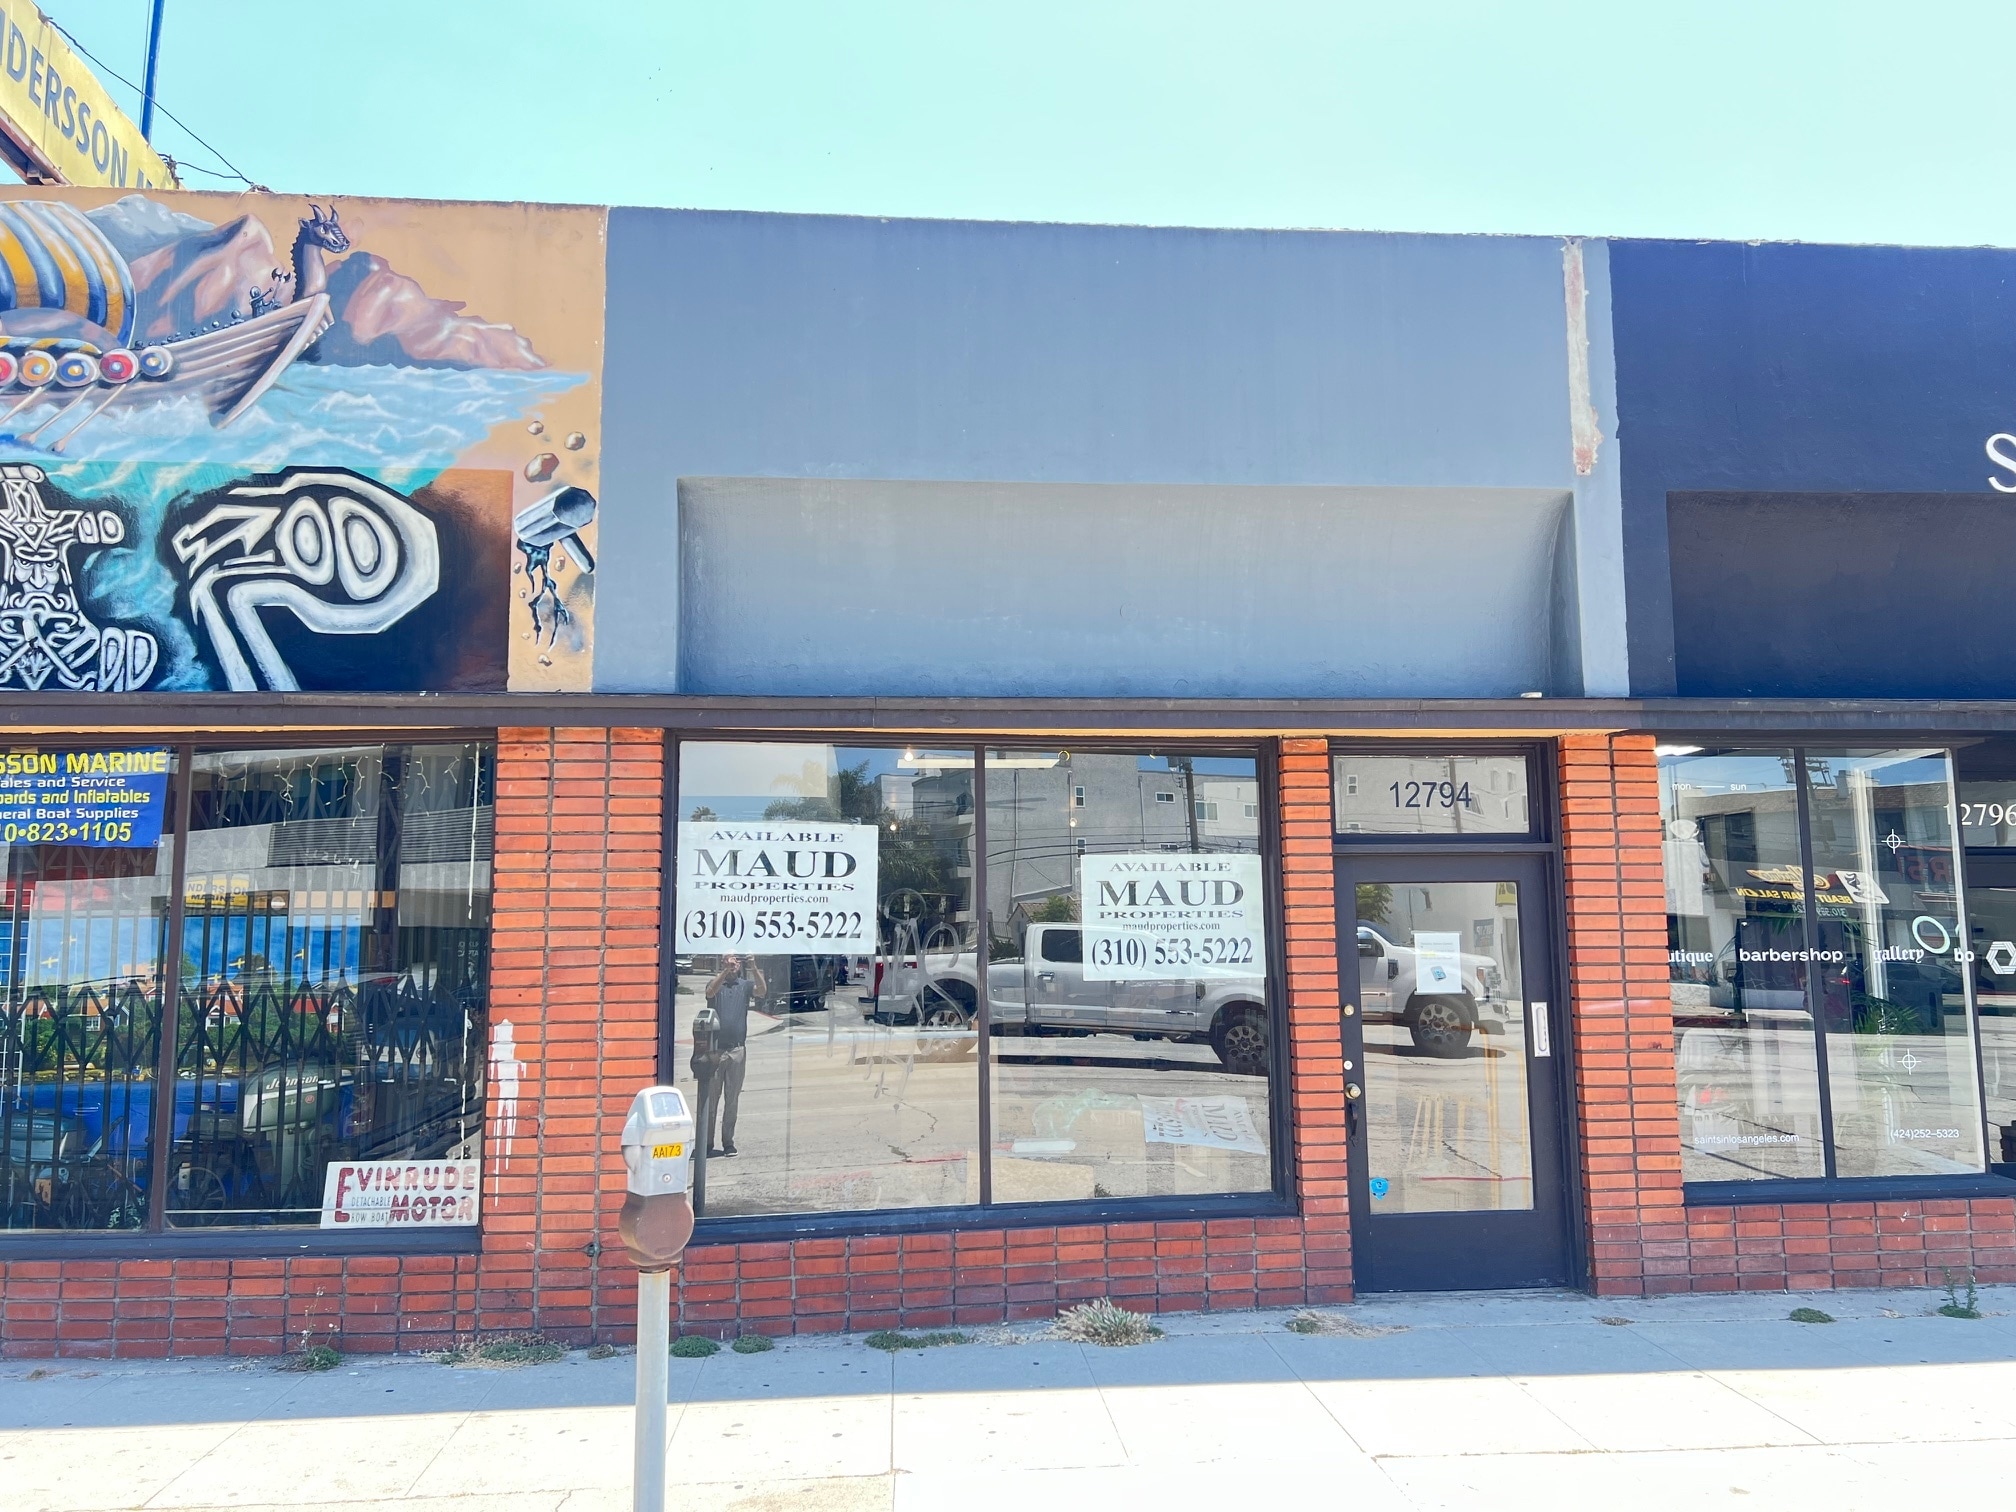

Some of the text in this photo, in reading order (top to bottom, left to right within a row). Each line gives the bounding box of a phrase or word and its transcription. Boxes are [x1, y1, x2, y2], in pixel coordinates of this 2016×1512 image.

[66, 751, 168, 774] MARINE
[37, 776, 66, 788] and
[71, 776, 126, 787] Service
[1671, 782, 1747, 791] mon sun
[42, 790, 70, 804] and
[73, 788, 151, 804] Inflatables
[1389, 781, 1472, 808] 12794
[36, 808, 71, 819] Boat
[76, 807, 139, 821] Supplies
[708, 830, 844, 843] AVAILABLE
[691, 848, 857, 879] MAUD
[1109, 862, 1231, 872] AVAILABLE
[692, 881, 856, 891] PROPERTIES
[1096, 879, 1244, 907] MAUD
[719, 892, 829, 905] maudproperties.com
[1098, 909, 1244, 919] PROPERTIES
[683, 909, 863, 945] (310) 553-5222
[1122, 921, 1221, 933] maudproperties.com
[1091, 937, 1254, 972] (310) 553-5222
[1739, 947, 1844, 963] barbershop
[1872, 946, 1925, 964] gallery
[1694, 1133, 1800, 1145] saintsinlosangeles.com
[334, 1165, 477, 1223] EVINRUDE
[351, 1196, 391, 1207] DETACHABLE
[389, 1194, 474, 1222] MOTOR
